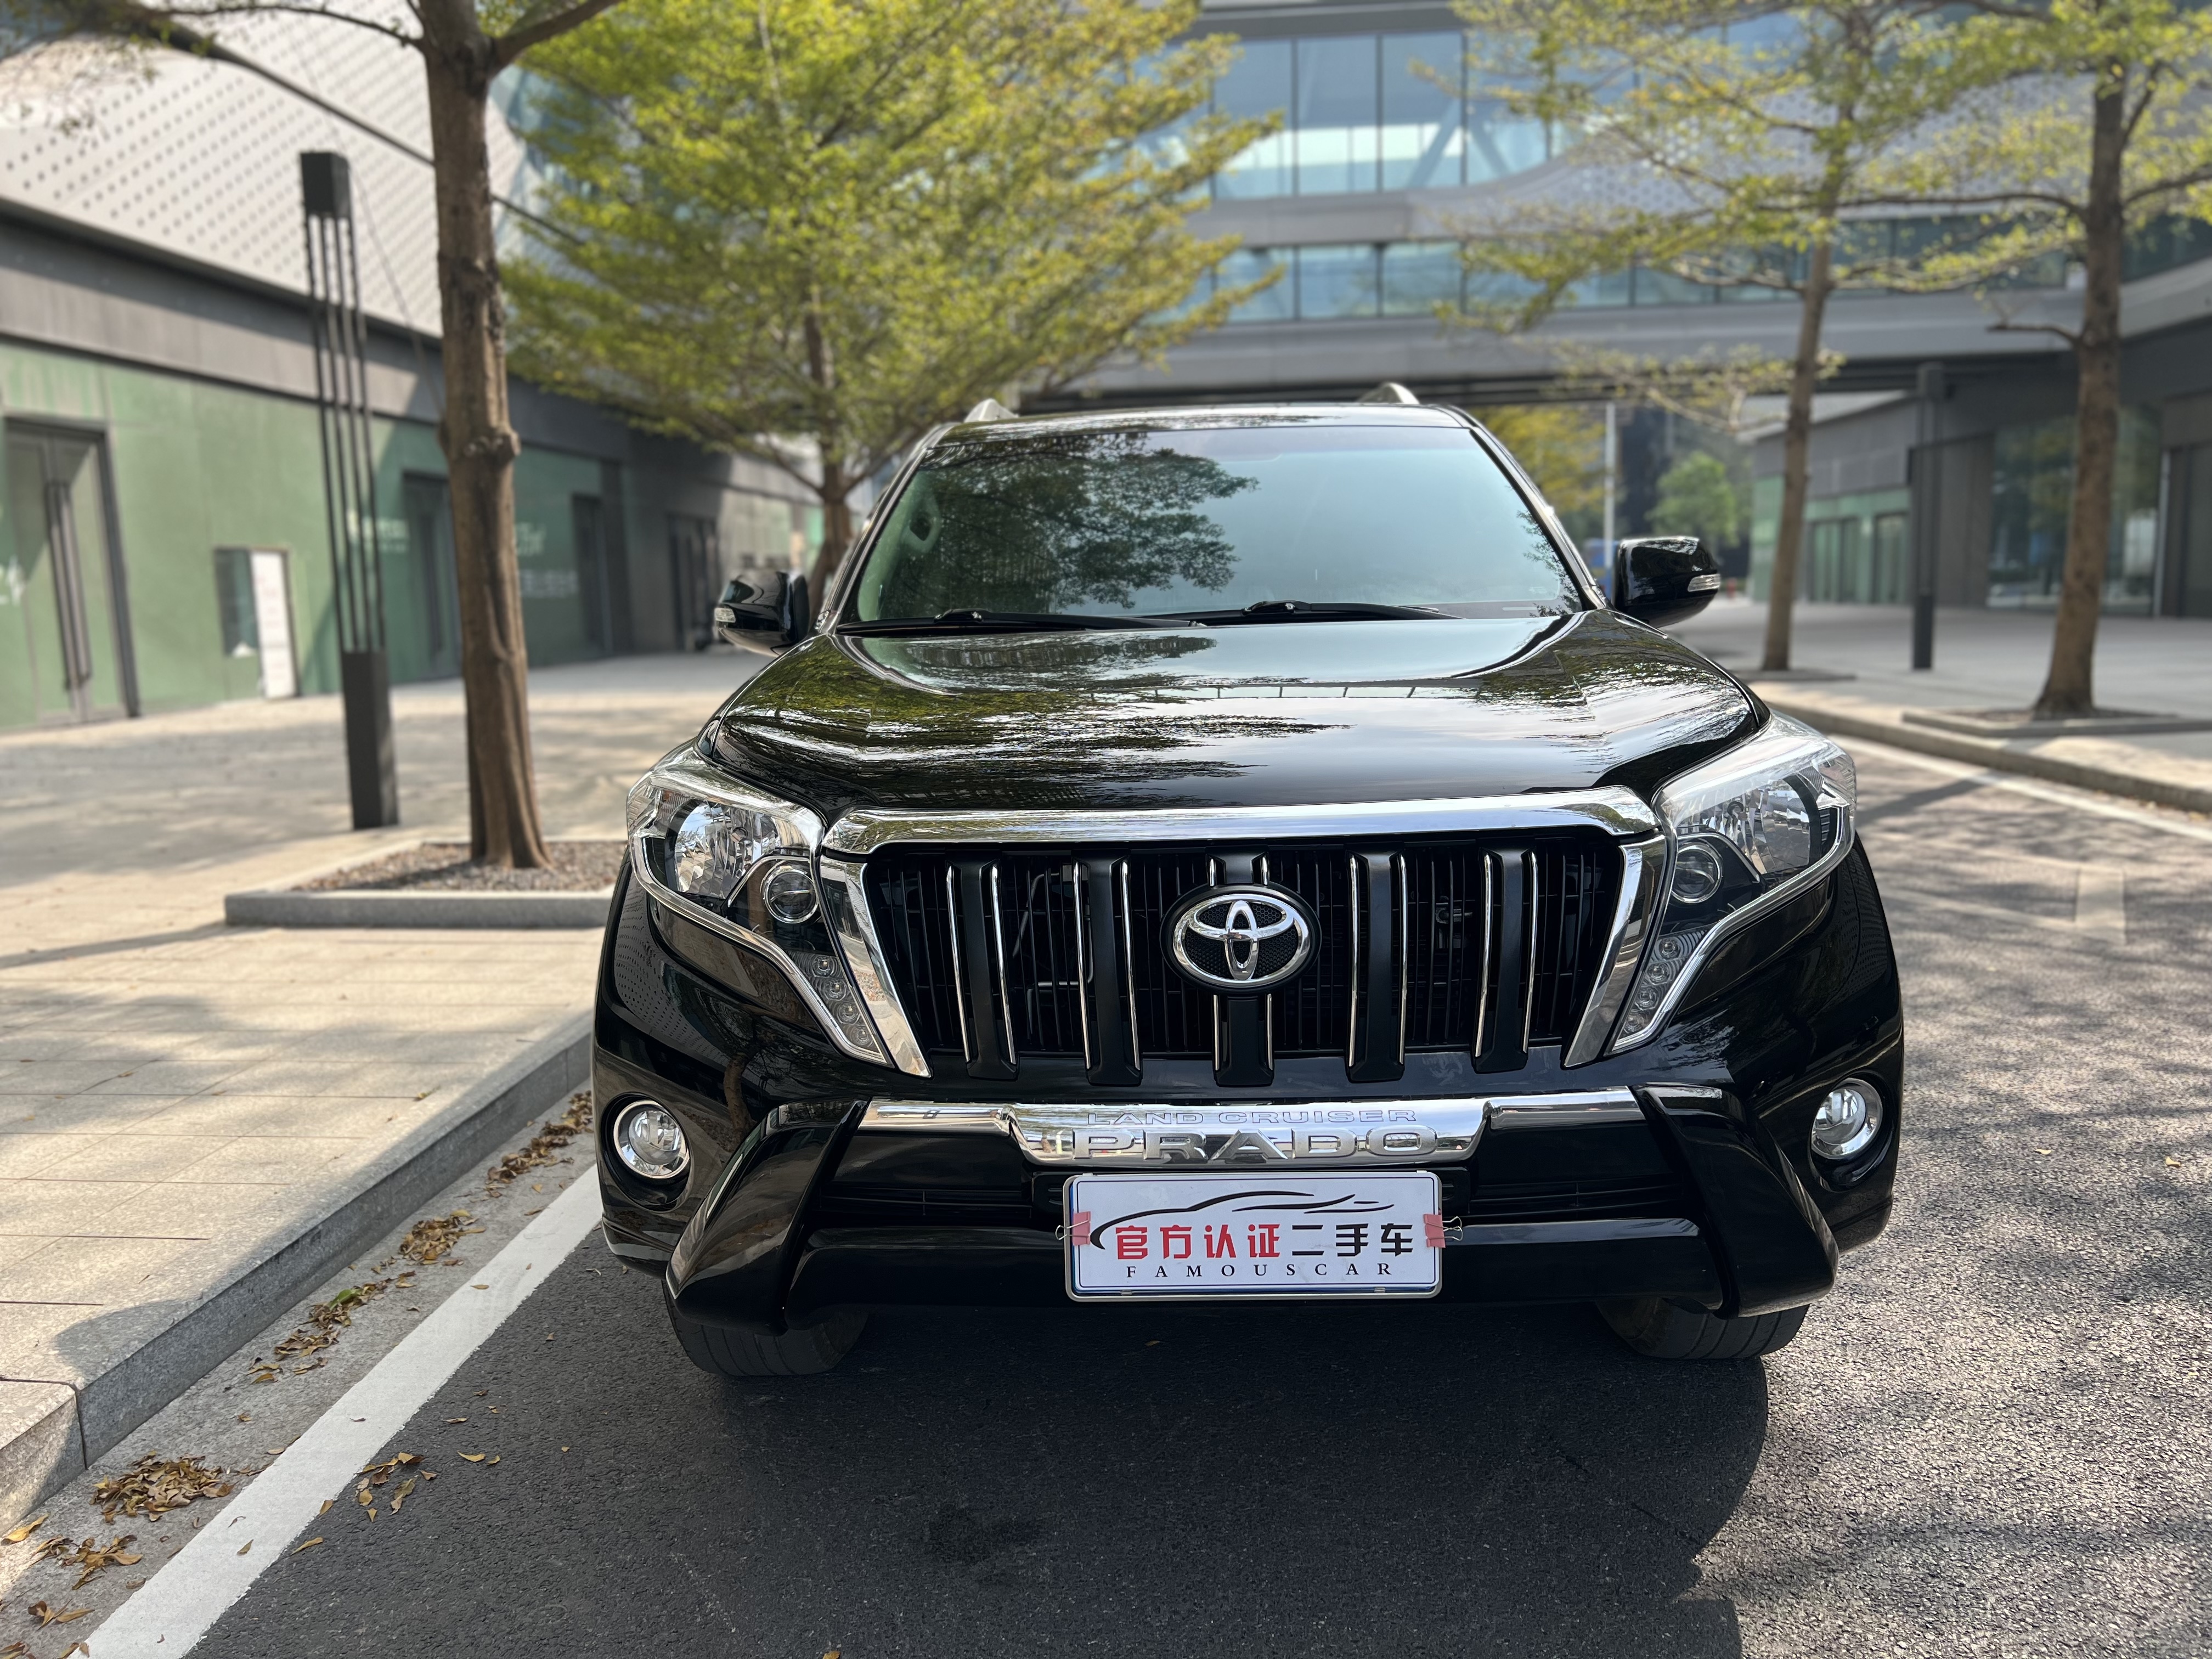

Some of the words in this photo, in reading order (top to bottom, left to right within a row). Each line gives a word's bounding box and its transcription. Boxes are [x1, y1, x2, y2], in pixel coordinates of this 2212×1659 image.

[1088, 1112, 1204, 1125] LAND
[1219, 1110, 1417, 1124] CRUISER
[1072, 1125, 1437, 1160] PRADO
[1116, 1222, 1413, 1260] 官方认证二手车
[1126, 1263, 1392, 1278] FAMOUSCAR
